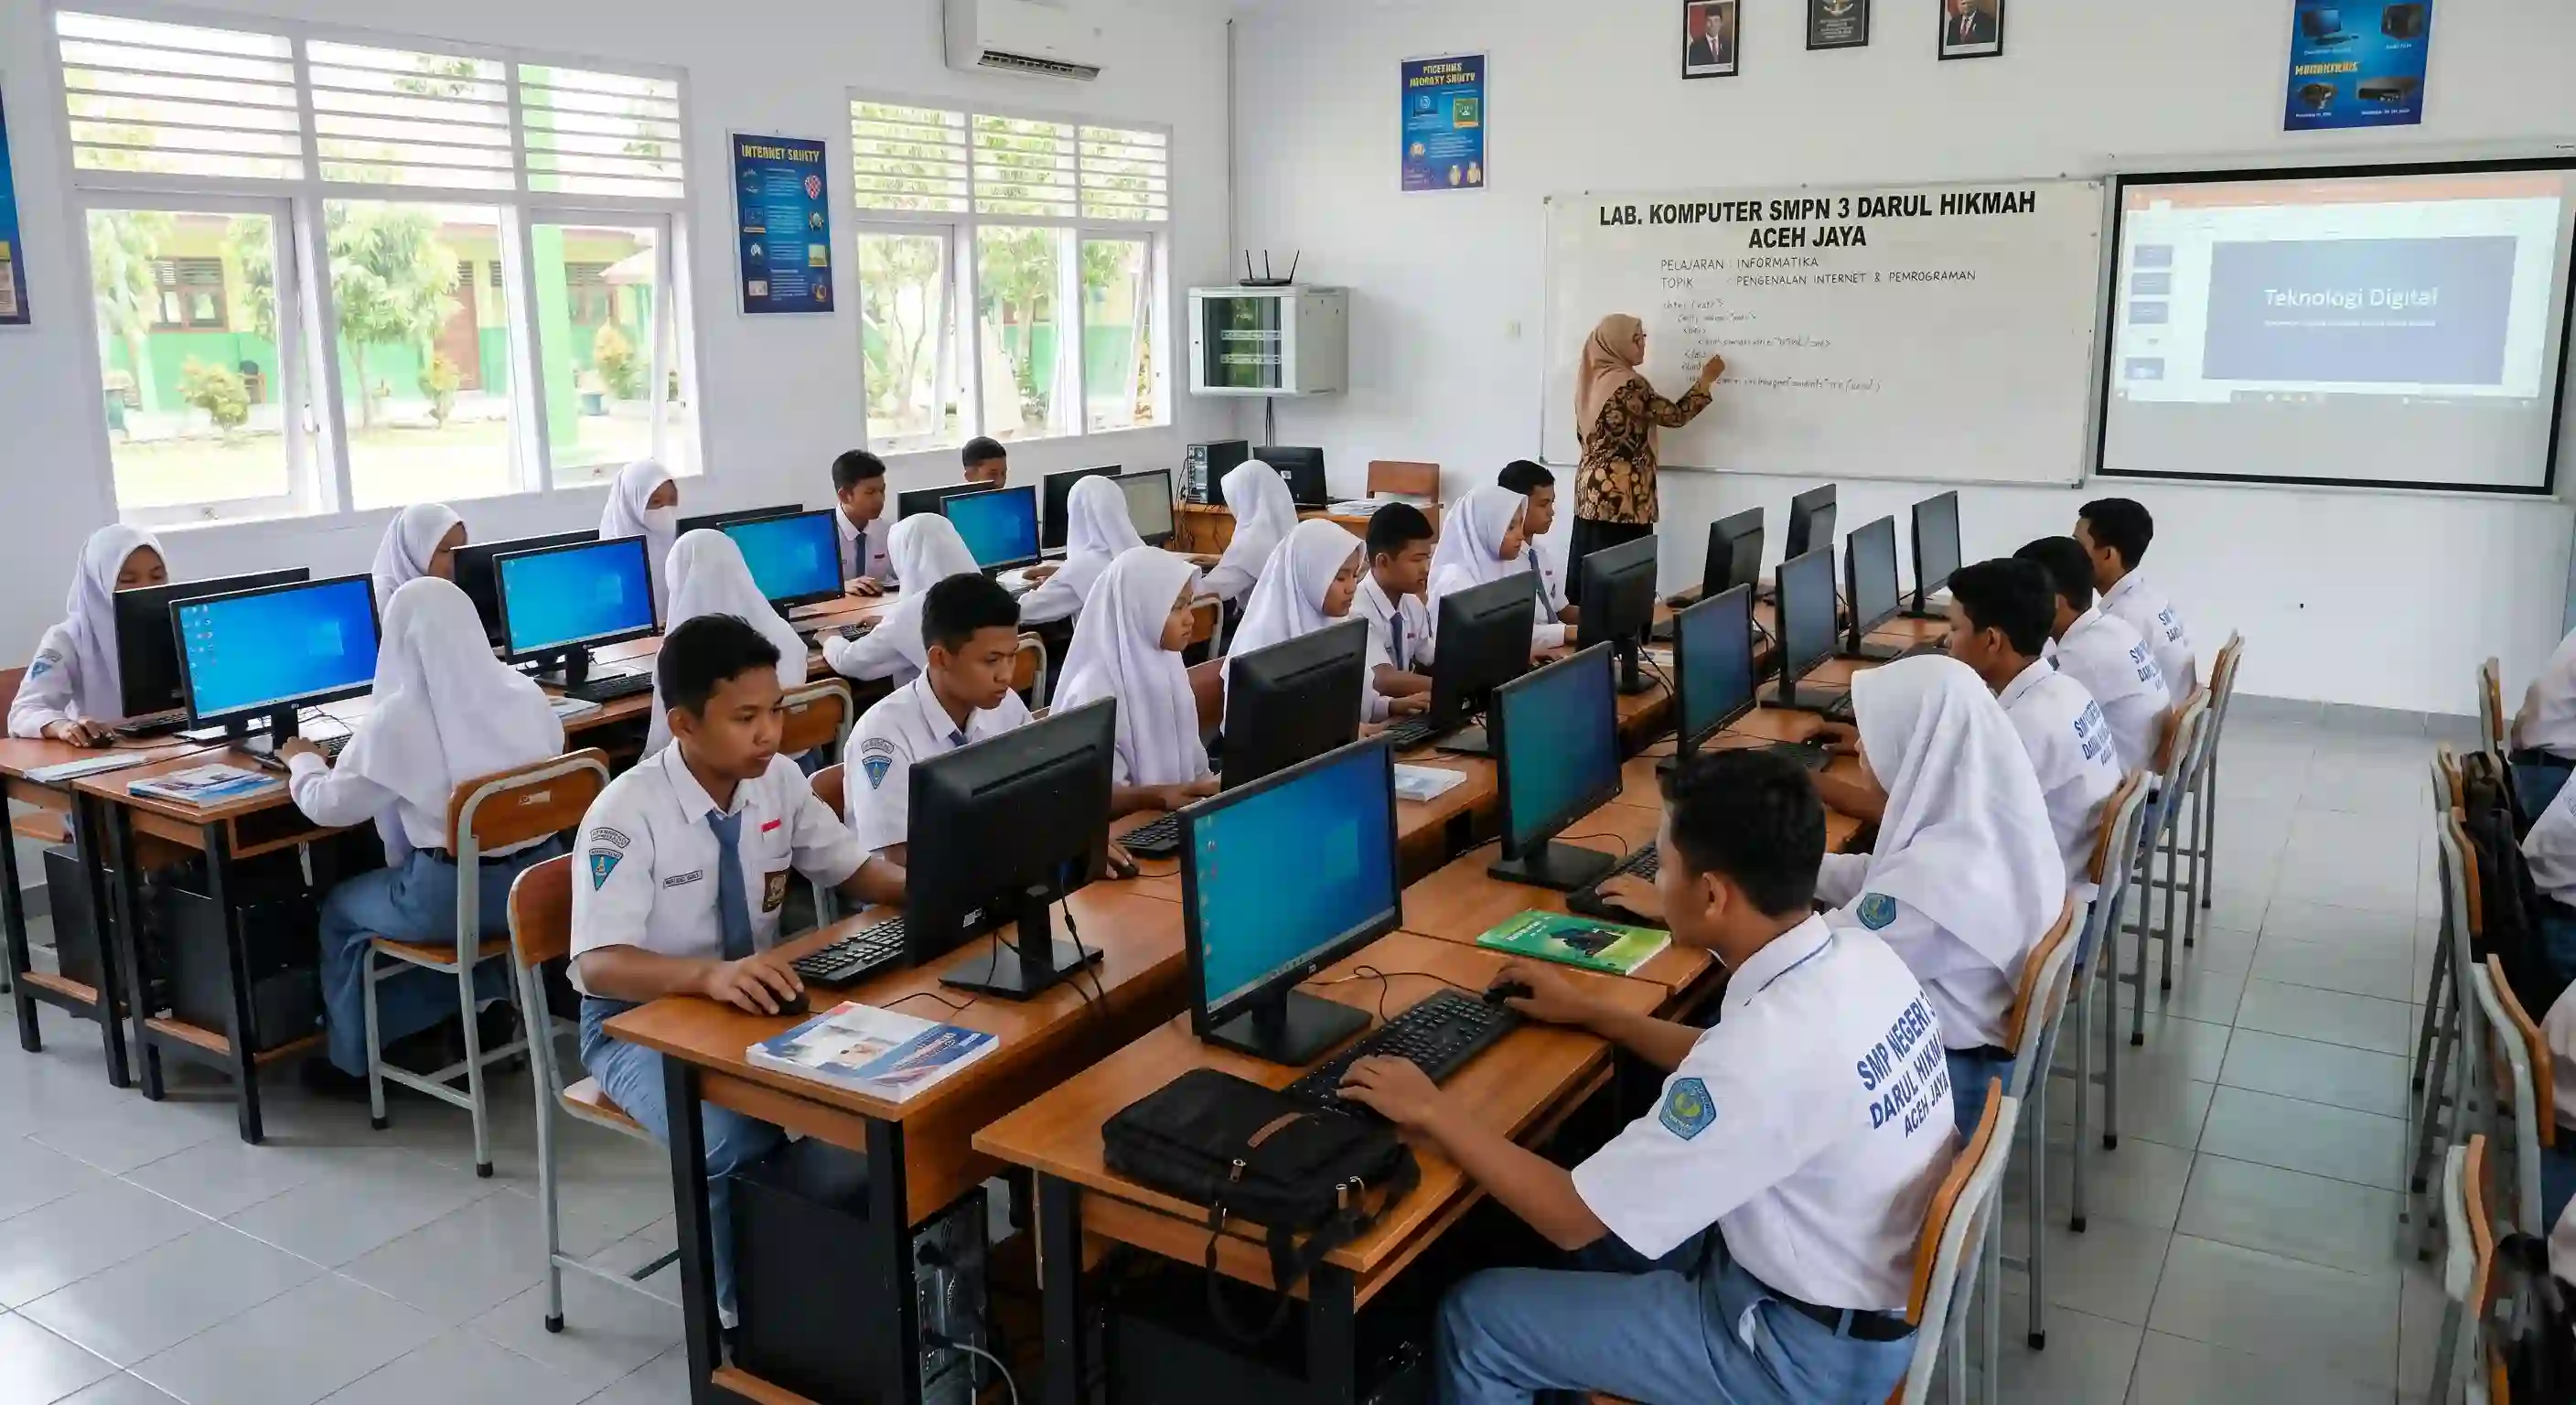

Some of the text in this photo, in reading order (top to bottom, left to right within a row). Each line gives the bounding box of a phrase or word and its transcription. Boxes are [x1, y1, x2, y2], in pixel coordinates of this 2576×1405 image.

[1600, 190, 2036, 226] LAB. KOMPUTER SMPN 3 DARUL HIKMAH
[1748, 225, 1867, 249] ACEH JAYA
[1661, 259, 1724, 271] PELAJARAN
[1737, 256, 1819, 269] INFORMATIKA
[1661, 277, 1694, 290] TOPIK
[1736, 275, 1807, 286] PENGENALAN
[1813, 273, 1867, 284] INTERNET
[1874, 272, 1881, 283] &
[1889, 271, 1976, 283] PEMROGRAMAN
[2263, 286, 2439, 310] Teknologi Digital
[1856, 1043, 1892, 1091] SMP
[1884, 998, 1931, 1063] NEGERI
[1869, 1070, 1919, 1130] DARUL
[1904, 1069, 1949, 1138] ACEH JAYA
